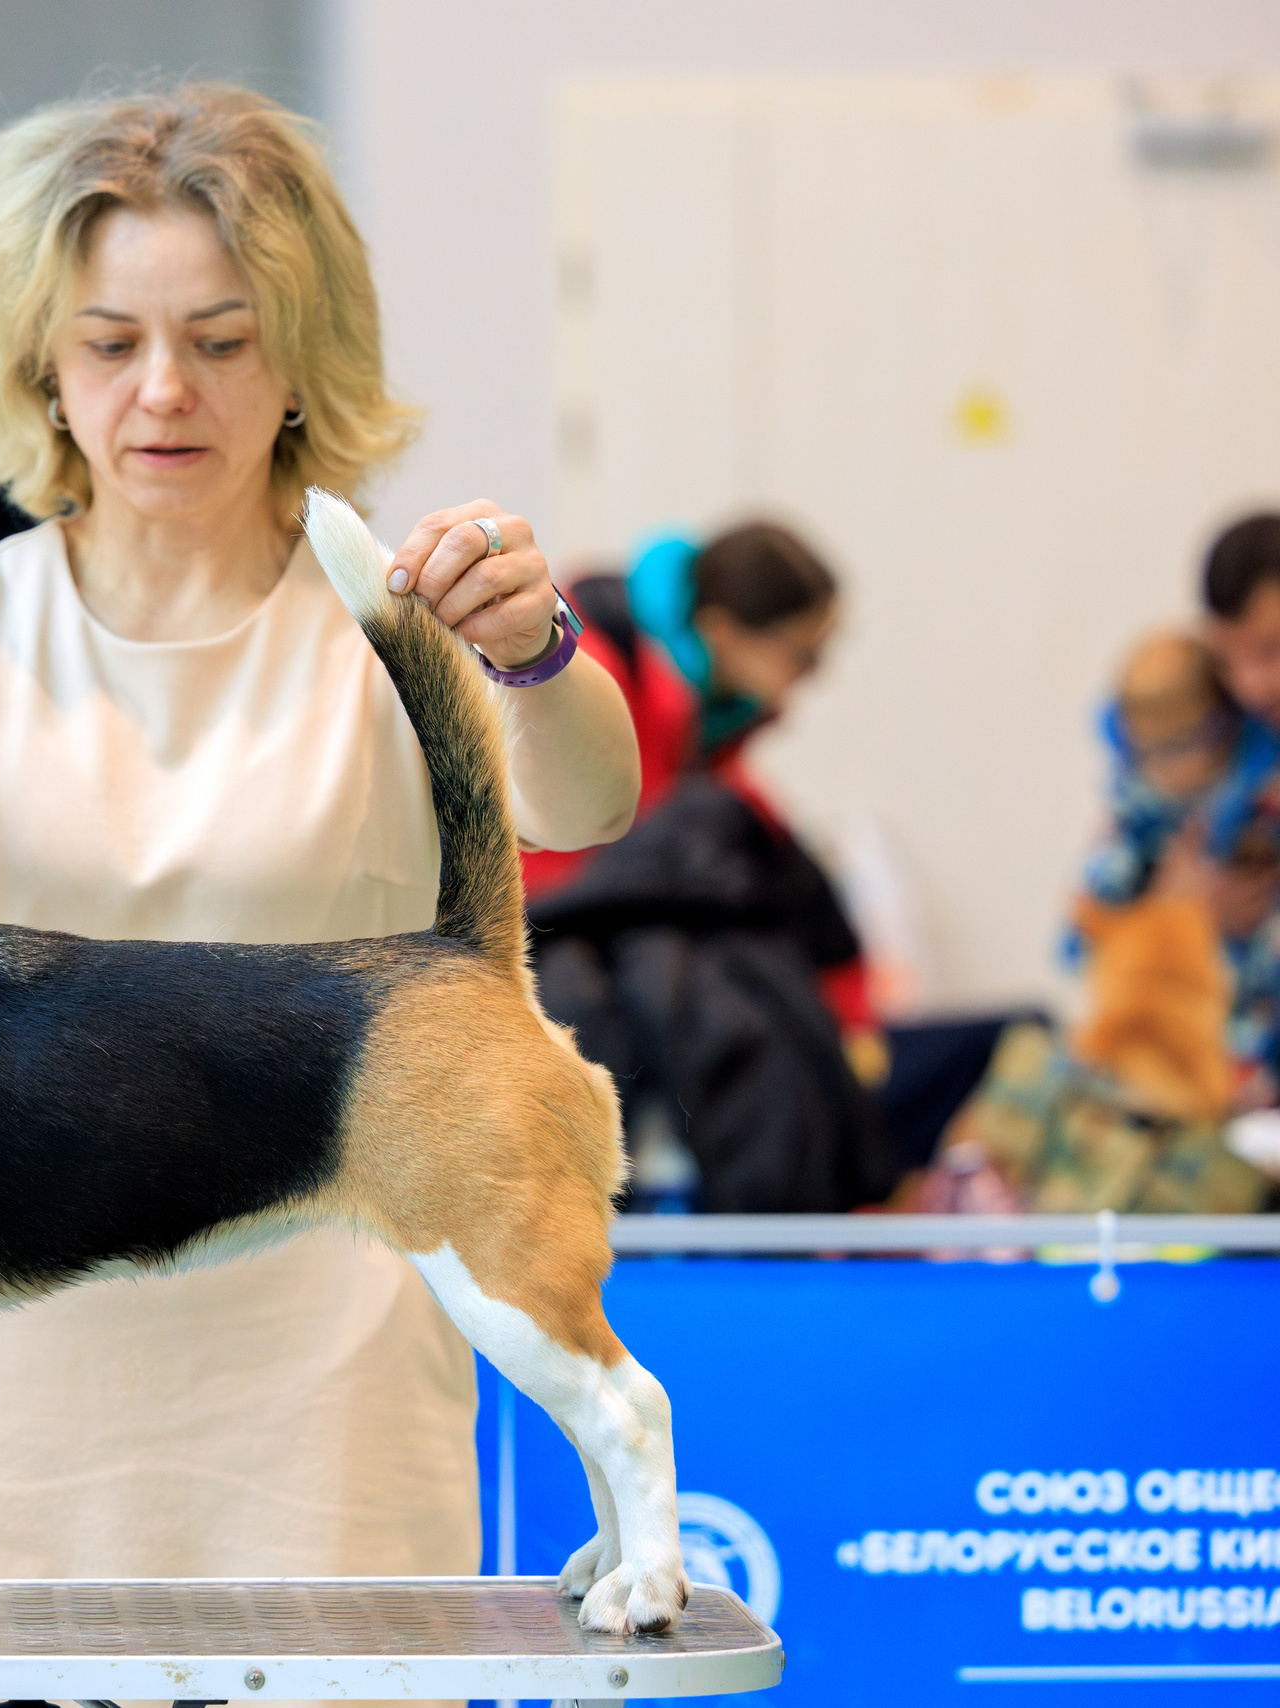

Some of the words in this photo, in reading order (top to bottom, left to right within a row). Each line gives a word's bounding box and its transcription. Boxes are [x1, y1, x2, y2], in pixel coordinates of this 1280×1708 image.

[976, 1470, 1128, 1514] СОЮЗ
[1135, 1469, 1280, 1518] ОБЩЕ
[1210, 1528, 1280, 1571] КИ
